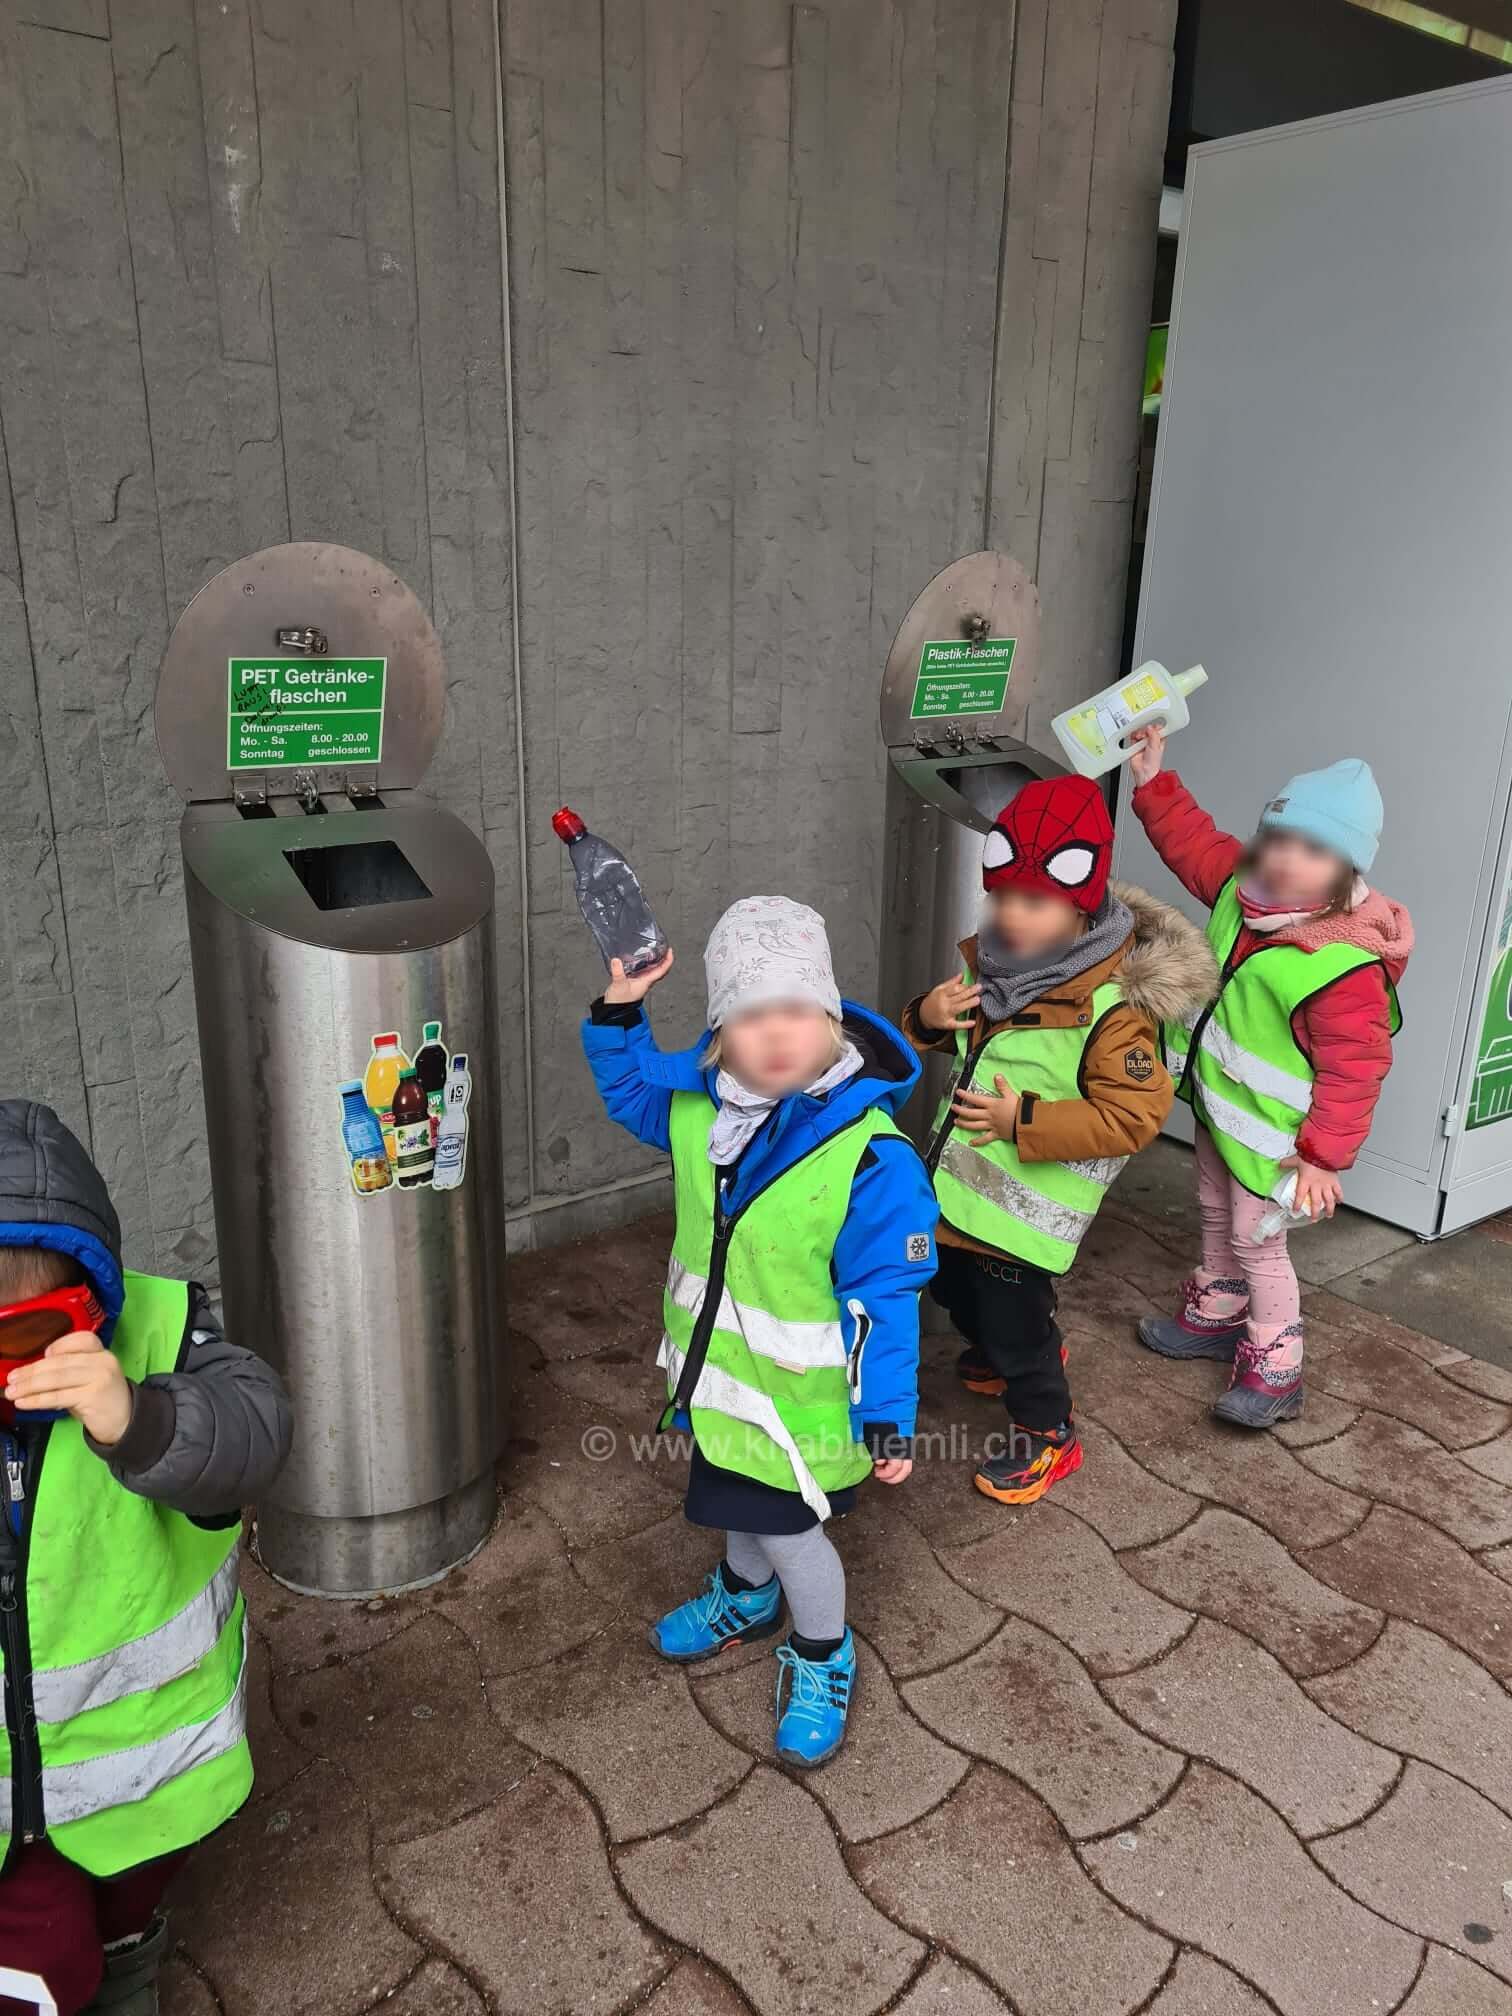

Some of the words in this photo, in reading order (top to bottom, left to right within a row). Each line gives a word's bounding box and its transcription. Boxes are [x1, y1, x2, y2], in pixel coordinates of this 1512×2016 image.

[927, 646, 1008, 660] Plastik-Flaschen
[241, 668, 280, 685] PET
[284, 667, 375, 685] Getränke-
[269, 688, 347, 705] flaschen
[923, 703, 947, 711] Sonntag
[241, 723, 322, 735] Öffnungszeiten:
[240, 736, 261, 746] Mo.
[271, 735, 288, 745] Sa.
[311, 734, 333, 744] 8.00
[342, 733, 369, 742] 20.00
[239, 749, 284, 760] Sonntag
[308, 746, 371, 758] geschlossen
